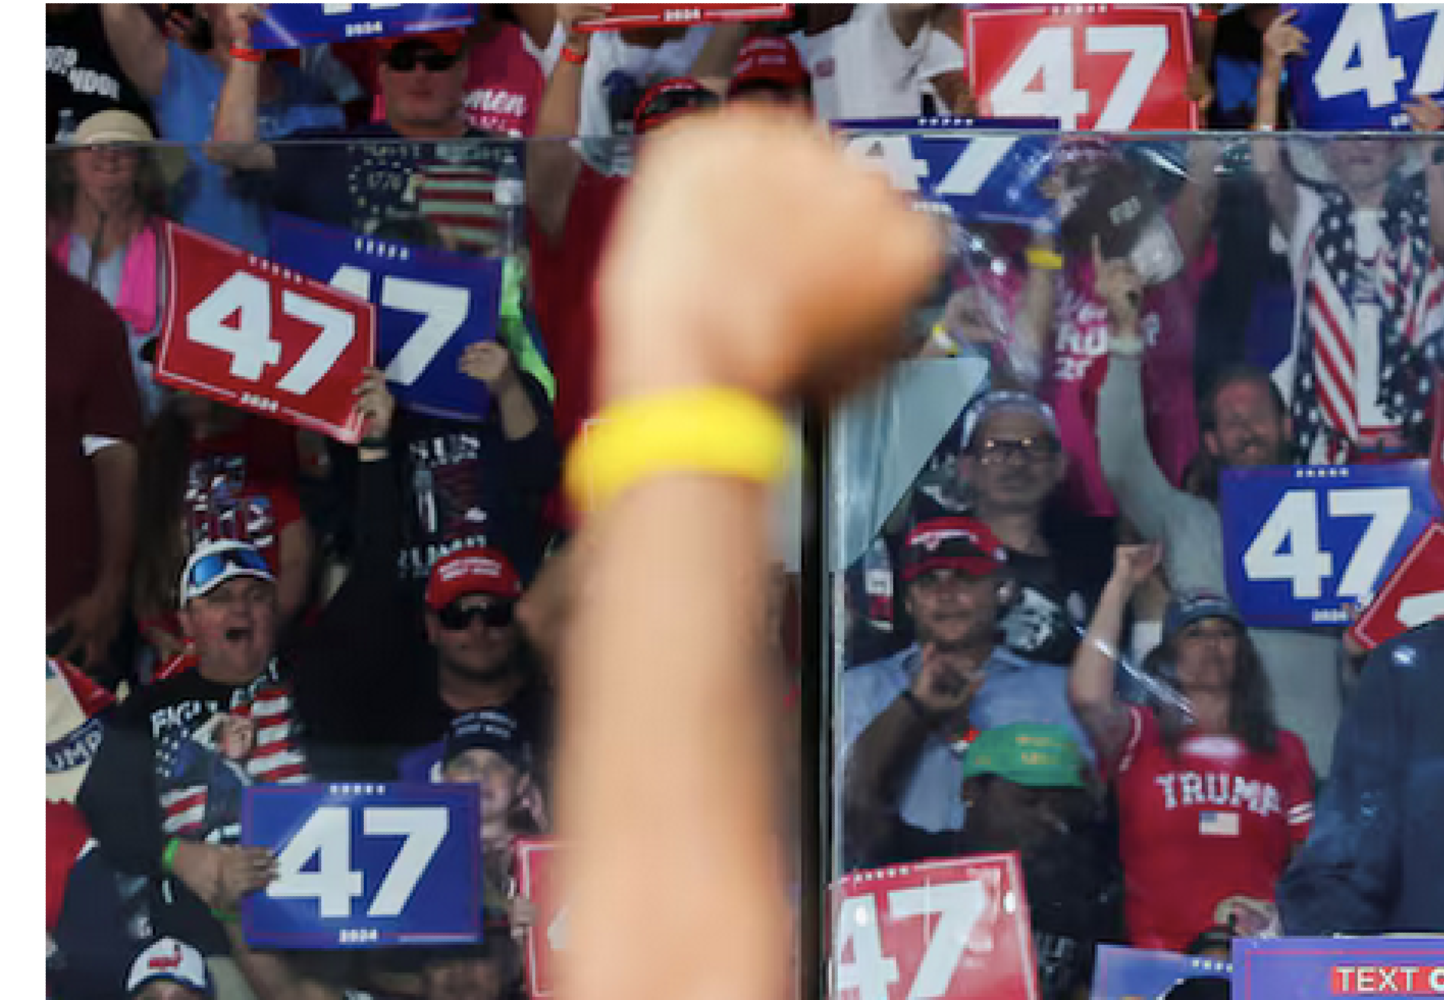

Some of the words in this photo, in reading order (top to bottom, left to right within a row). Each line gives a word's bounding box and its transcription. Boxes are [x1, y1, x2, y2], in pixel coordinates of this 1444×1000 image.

[991, 25, 1168, 130] 47
[186, 271, 356, 395] 47
[1243, 488, 1410, 604] 47
[1155, 772, 1282, 817] TRUMP
[265, 807, 449, 917] 47
[1336, 967, 1418, 991] TEXT
